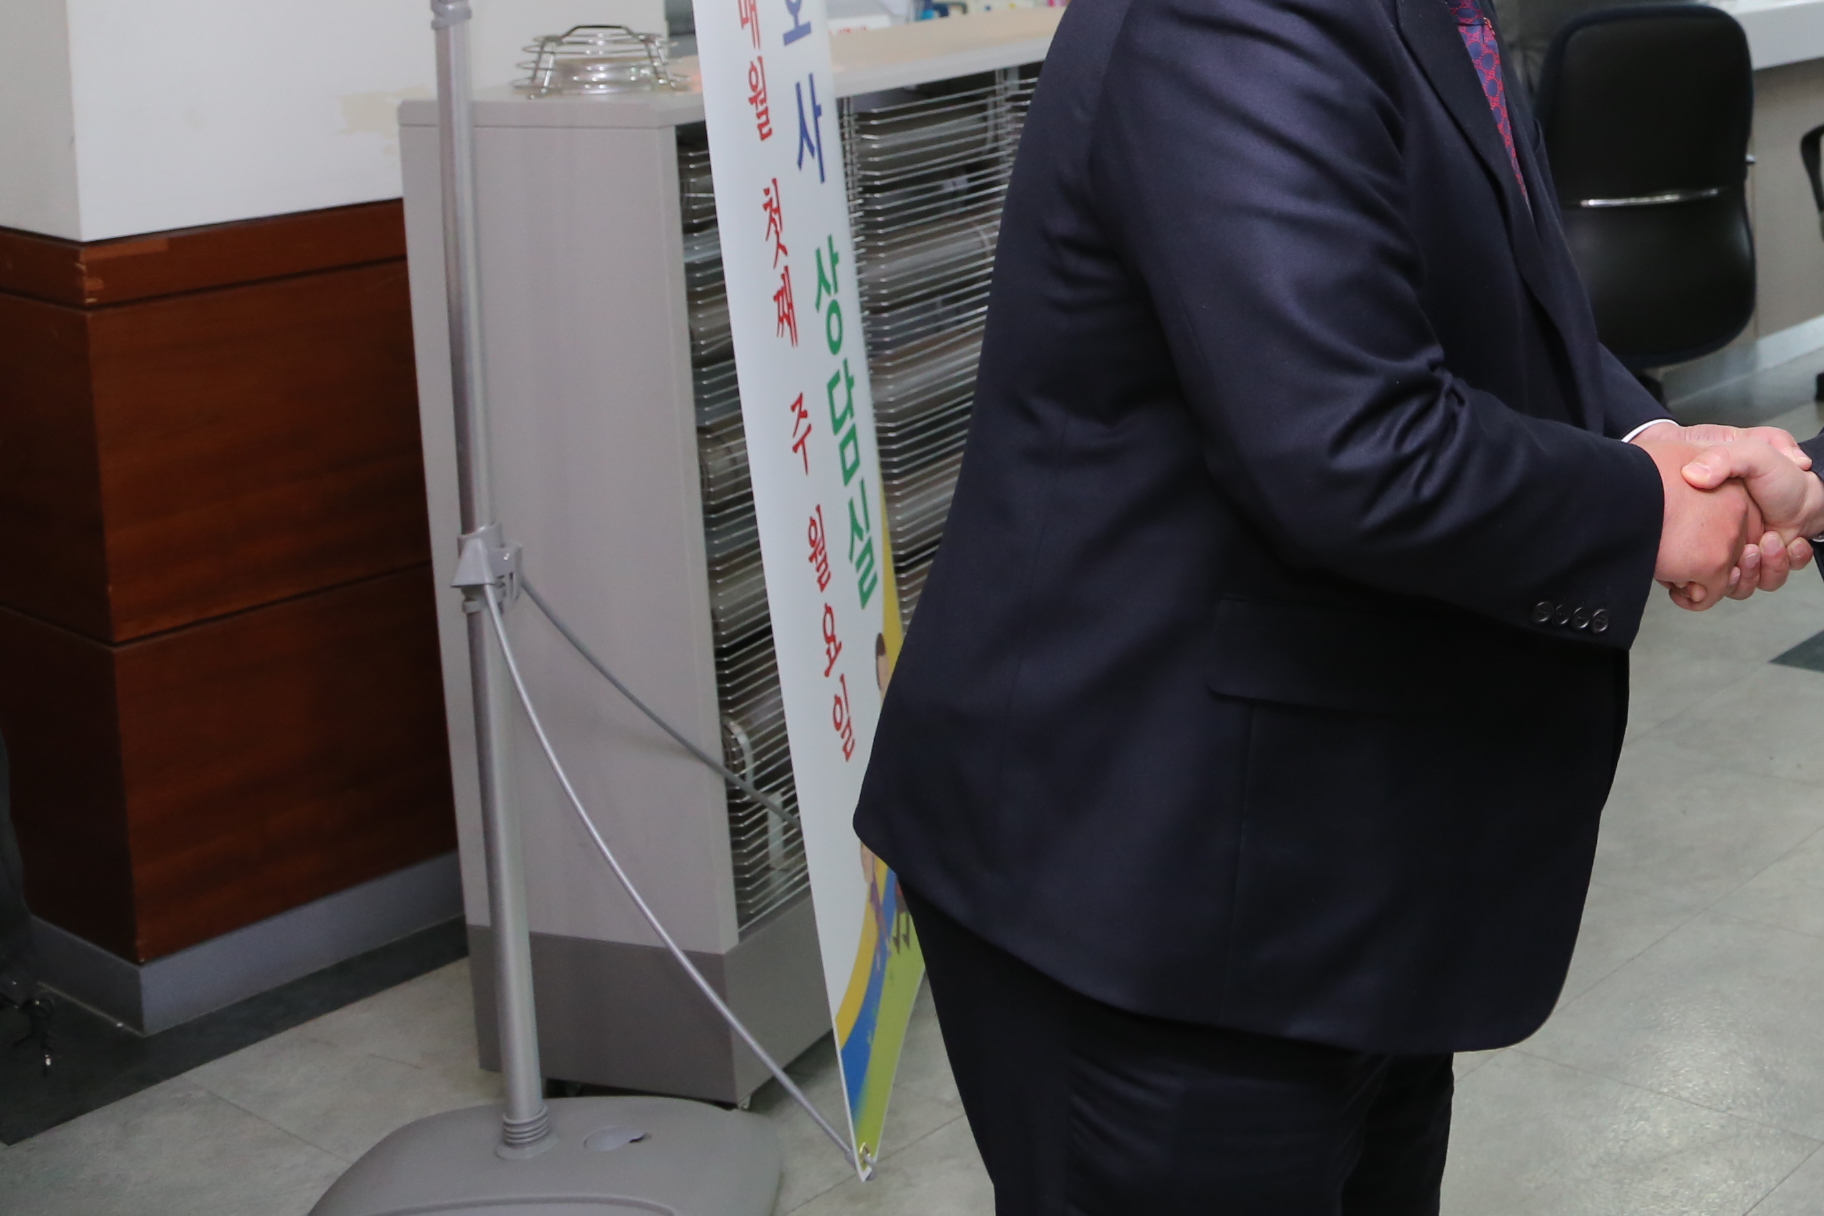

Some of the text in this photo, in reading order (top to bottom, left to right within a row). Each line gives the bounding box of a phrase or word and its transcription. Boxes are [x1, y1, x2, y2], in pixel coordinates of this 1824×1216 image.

[762, 177, 798, 348] 첫째
[790, 391, 812, 476] 주
[814, 233, 878, 610] 상담실
